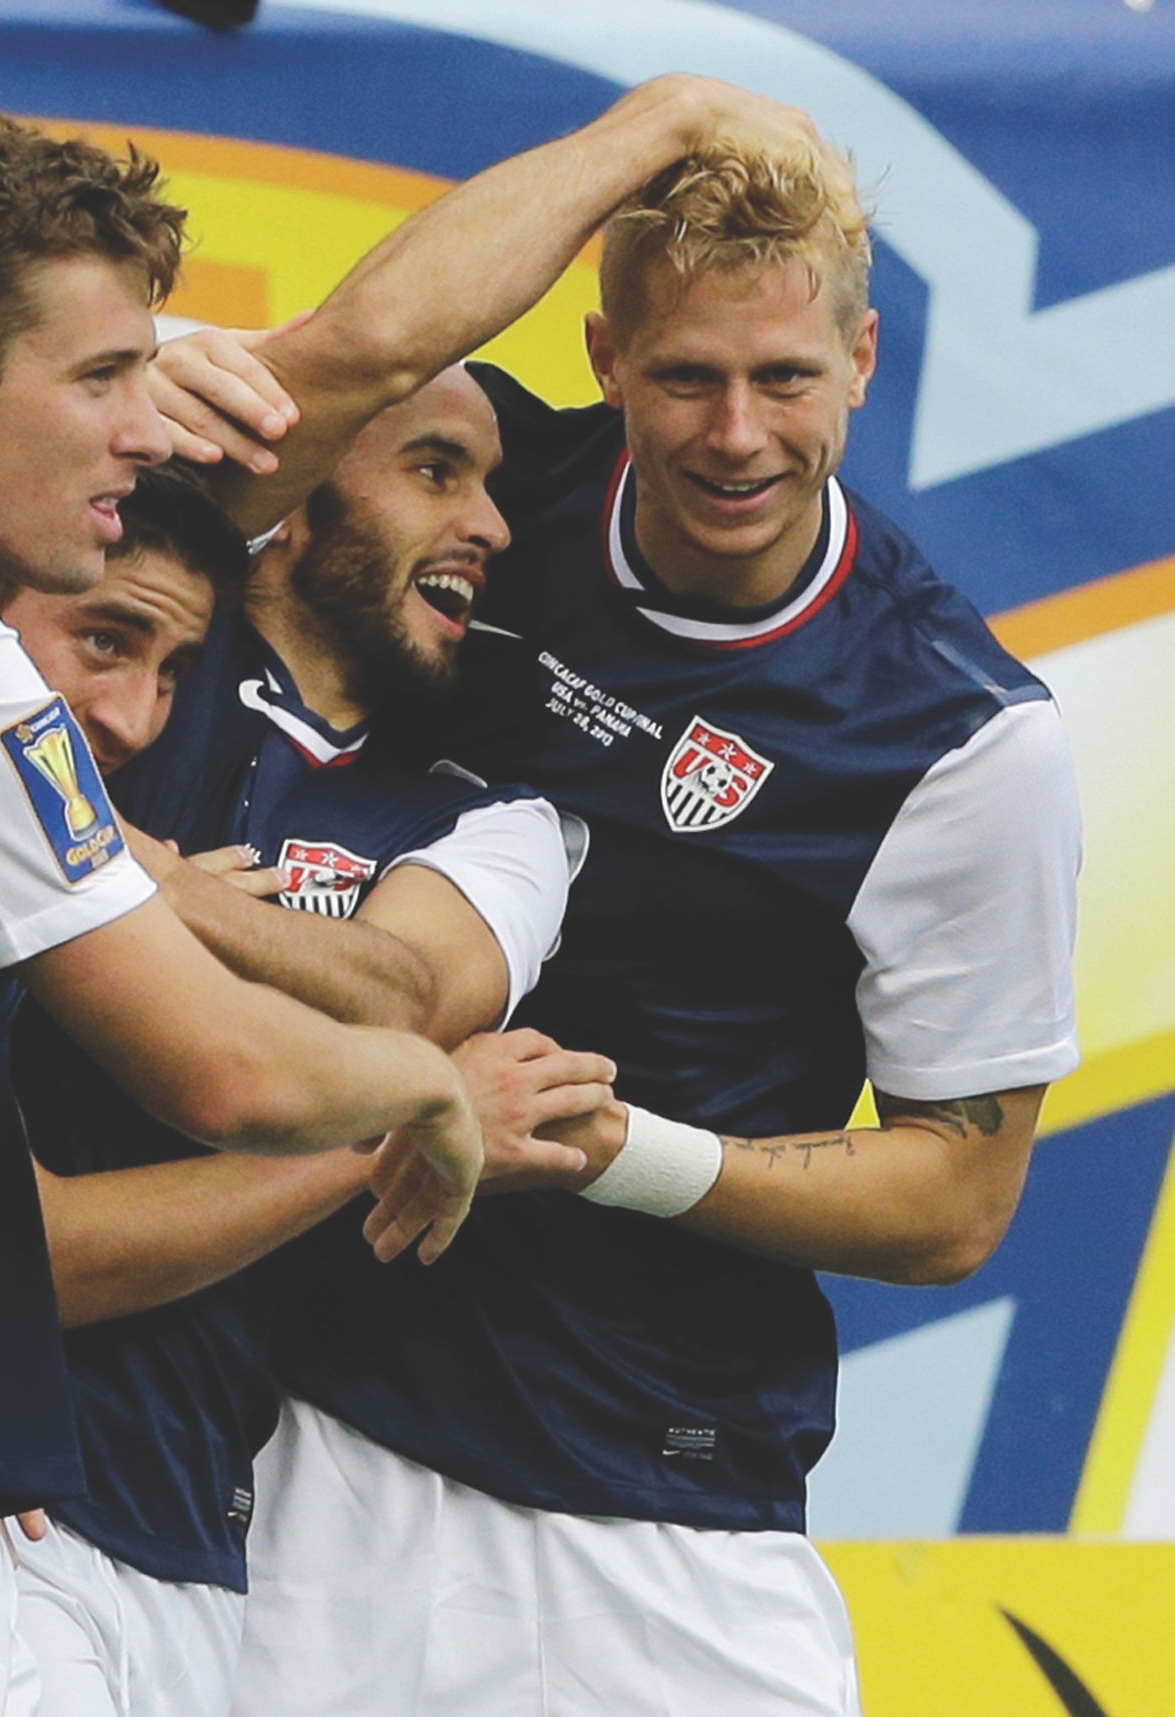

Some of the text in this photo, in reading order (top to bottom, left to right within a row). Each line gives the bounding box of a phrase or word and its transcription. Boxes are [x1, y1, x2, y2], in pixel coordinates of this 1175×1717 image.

[551, 681, 574, 703] USA
[584, 684, 616, 708] GOLD
[545, 697, 575, 716] JULY
